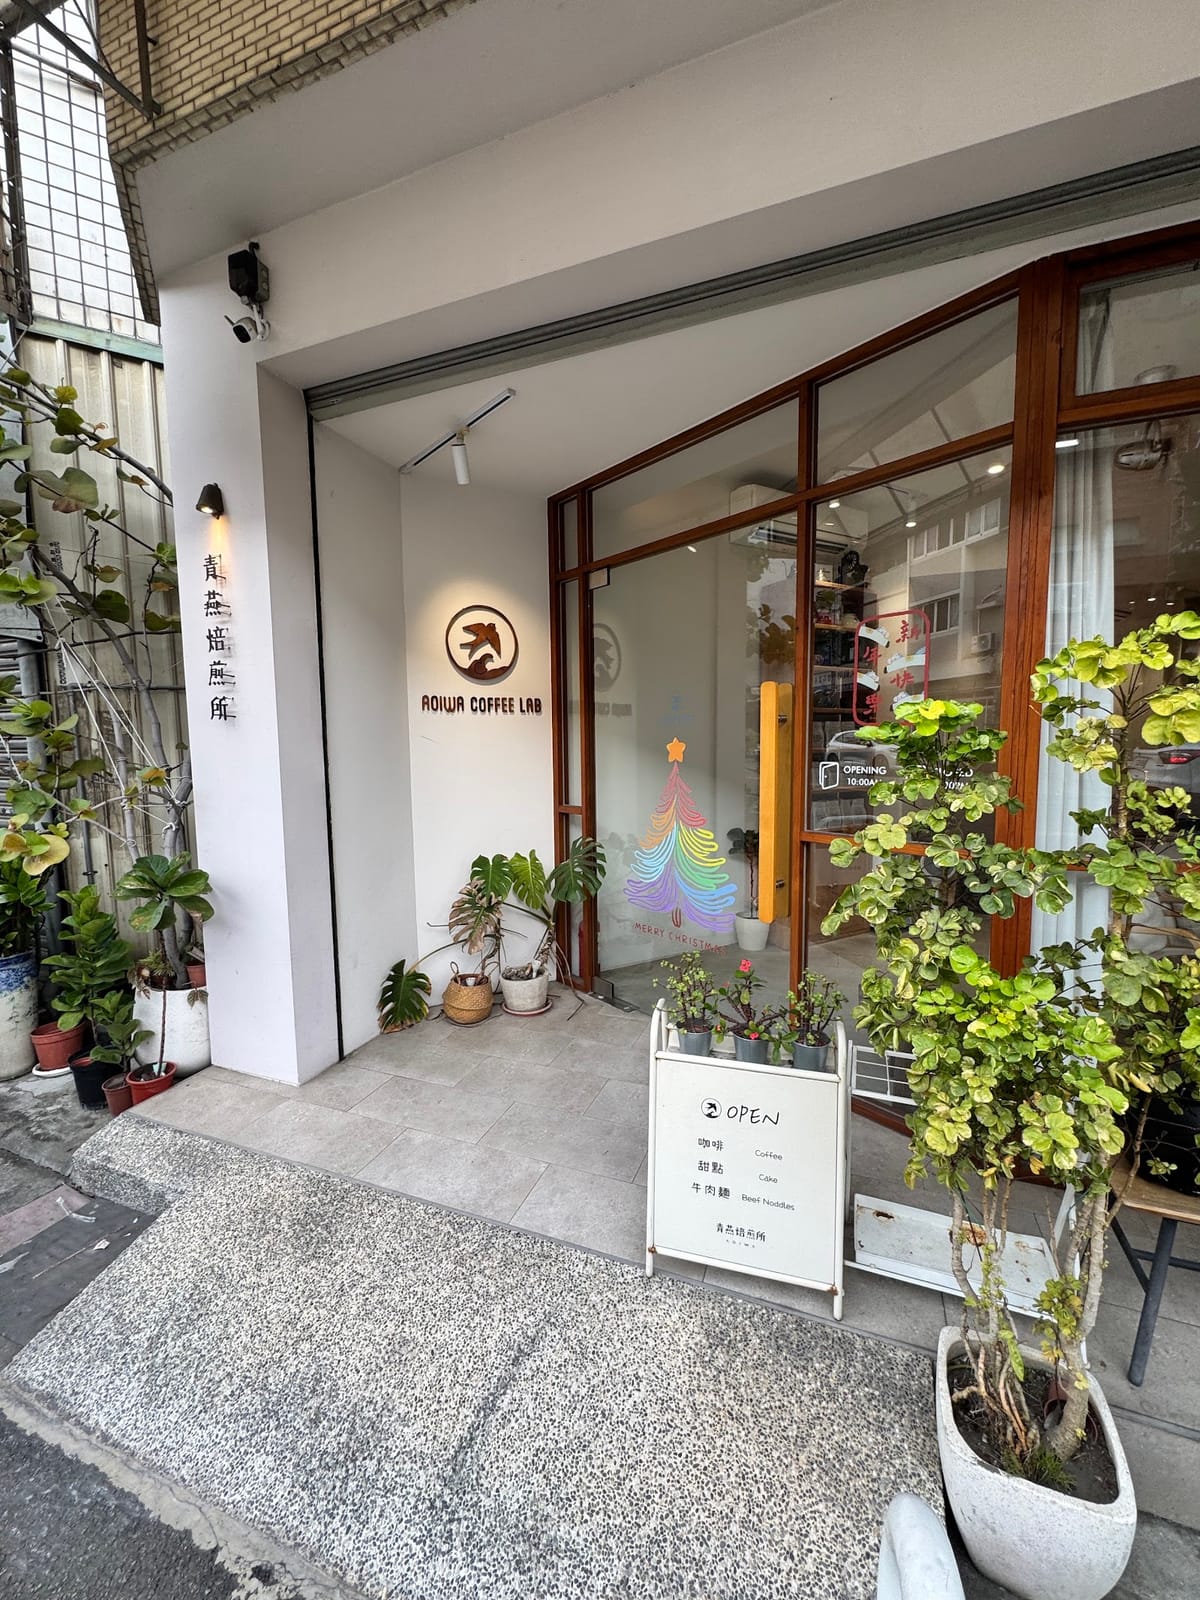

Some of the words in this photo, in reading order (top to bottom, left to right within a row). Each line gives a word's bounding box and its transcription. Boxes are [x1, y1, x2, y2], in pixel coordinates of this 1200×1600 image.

[421, 695, 465, 713] AOIWA
[470, 696, 515, 713] COFFEE
[520, 697, 543, 714] LAB
[843, 765, 887, 775] OPENING
[633, 922, 665, 937] MERRY
[726, 1105, 780, 1126] OPEN
[697, 1137, 724, 1152] 咖啡
[754, 1149, 783, 1161] Coffee
[697, 1160, 724, 1175] 甜點
[758, 1173, 778, 1184] Cake
[691, 1182, 731, 1199] 牛肉麵
[741, 1194, 761, 1205] Beef
